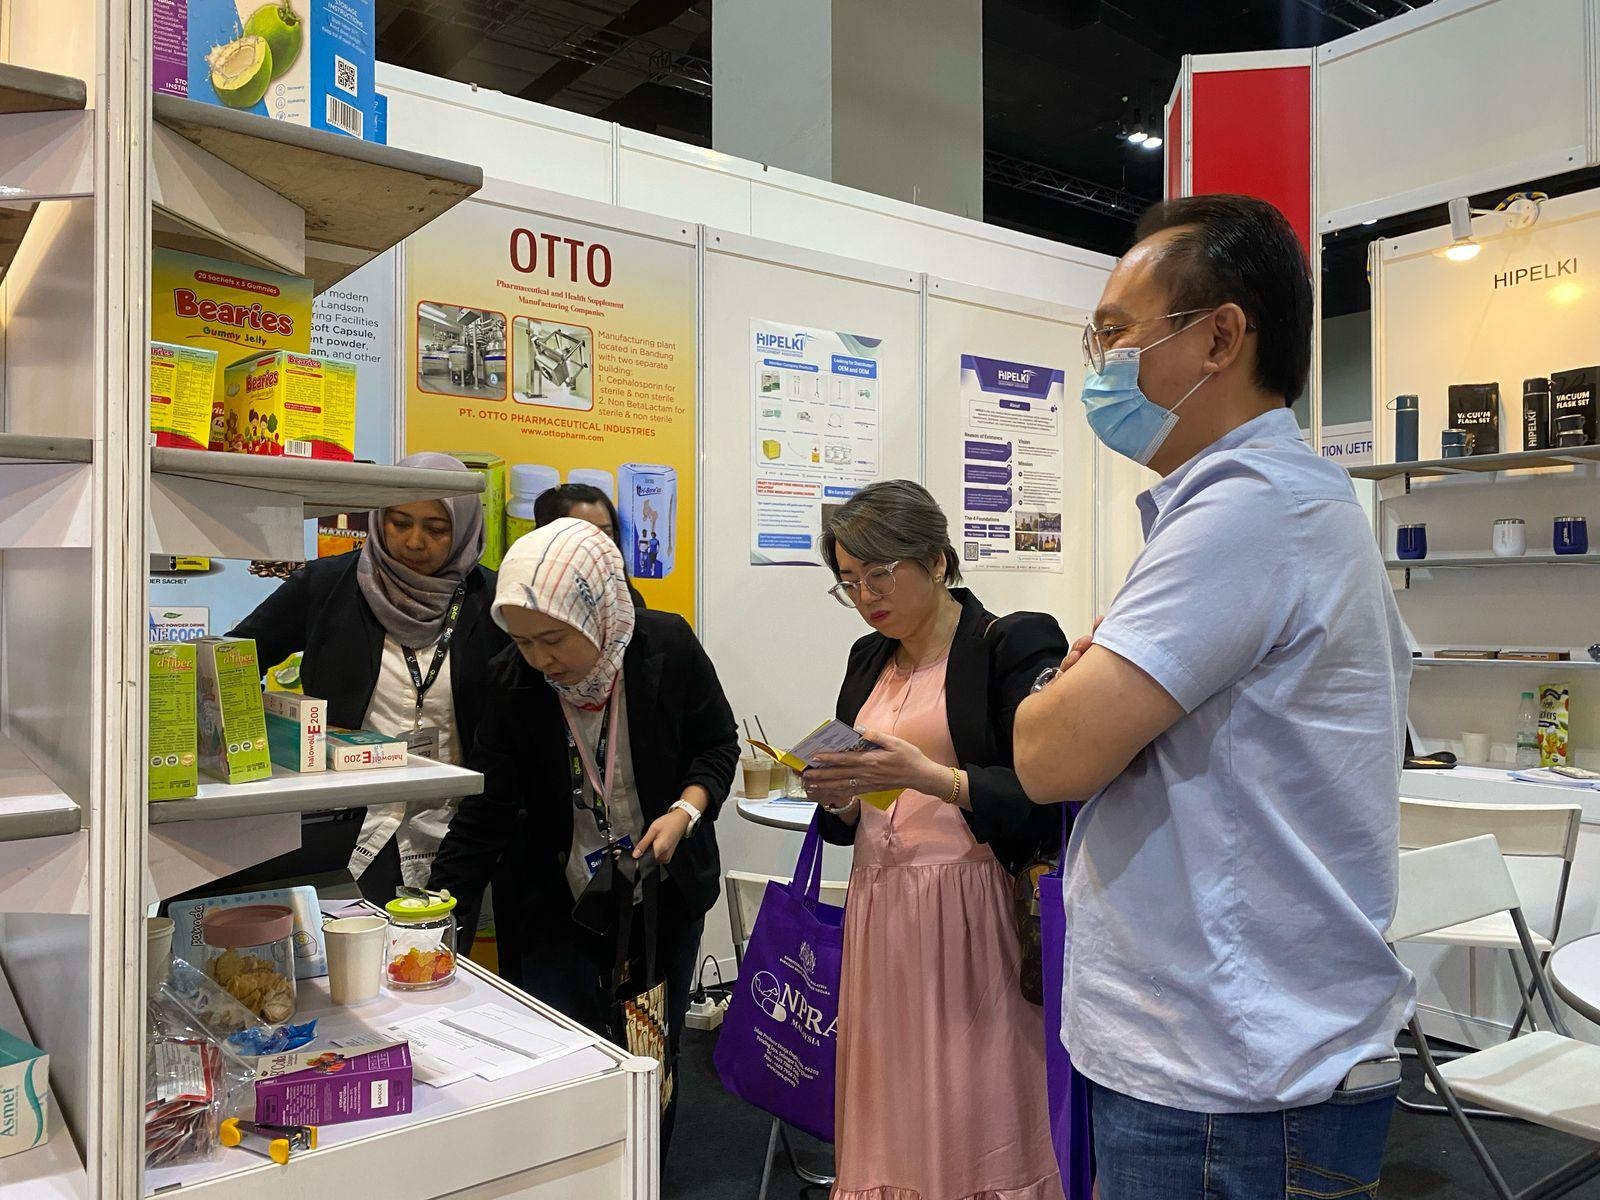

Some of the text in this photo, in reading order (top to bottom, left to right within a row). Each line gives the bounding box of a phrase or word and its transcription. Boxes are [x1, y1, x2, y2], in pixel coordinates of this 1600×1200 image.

[510, 228, 612, 288] OTTO
[1494, 257, 1577, 289] HIPELKI
[208, 273, 235, 286] Sachets
[247, 282, 277, 295] Gummies
[329, 290, 369, 302] modern
[496, 279, 624, 309] Pharmaceutical and Health Supplement
[174, 288, 294, 336] Bearies
[321, 300, 364, 313] Landson
[518, 295, 605, 317] Manufacturing Companies
[335, 313, 379, 327] Facilities
[203, 327, 267, 346] Gummy Jelly
[333, 326, 376, 340] Capsule,
[598, 330, 676, 350] Manufacturing plant
[756, 332, 804, 351] HIPELKI
[326, 338, 369, 350] powder,
[598, 341, 628, 353] located
[640, 348, 674, 361] Bandung
[332, 351, 352, 360] and
[355, 354, 382, 363] other
[598, 353, 669, 370] with two separate
[245, 370, 279, 394] Bearies
[606, 375, 663, 390] Cephalosporin
[665, 384, 676, 392] for
[998, 370, 1029, 384] HIPELKI
[600, 387, 674, 403] sterile & non sterile
[1556, 391, 1590, 402] VACUUM
[598, 397, 686, 414] 2. Non BetaLactam for
[1556, 400, 1577, 409] FLASK
[459, 408, 656, 437] PT. OTTO PHARMACEUTICAL INDUSTRIES
[598, 409, 623, 418] sterile
[633, 412, 648, 420] non
[649, 414, 673, 423] sterile
[1457, 411, 1491, 419] VACUUM
[521, 427, 604, 442] www.ottopharm.com
[1528, 410, 1537, 447] HIPELKI
[311, 706, 319, 724] 200
[344, 754, 361, 763] 200
[779, 983, 838, 1040] NPRA
[0, 1087, 15, 1137] Asmef
